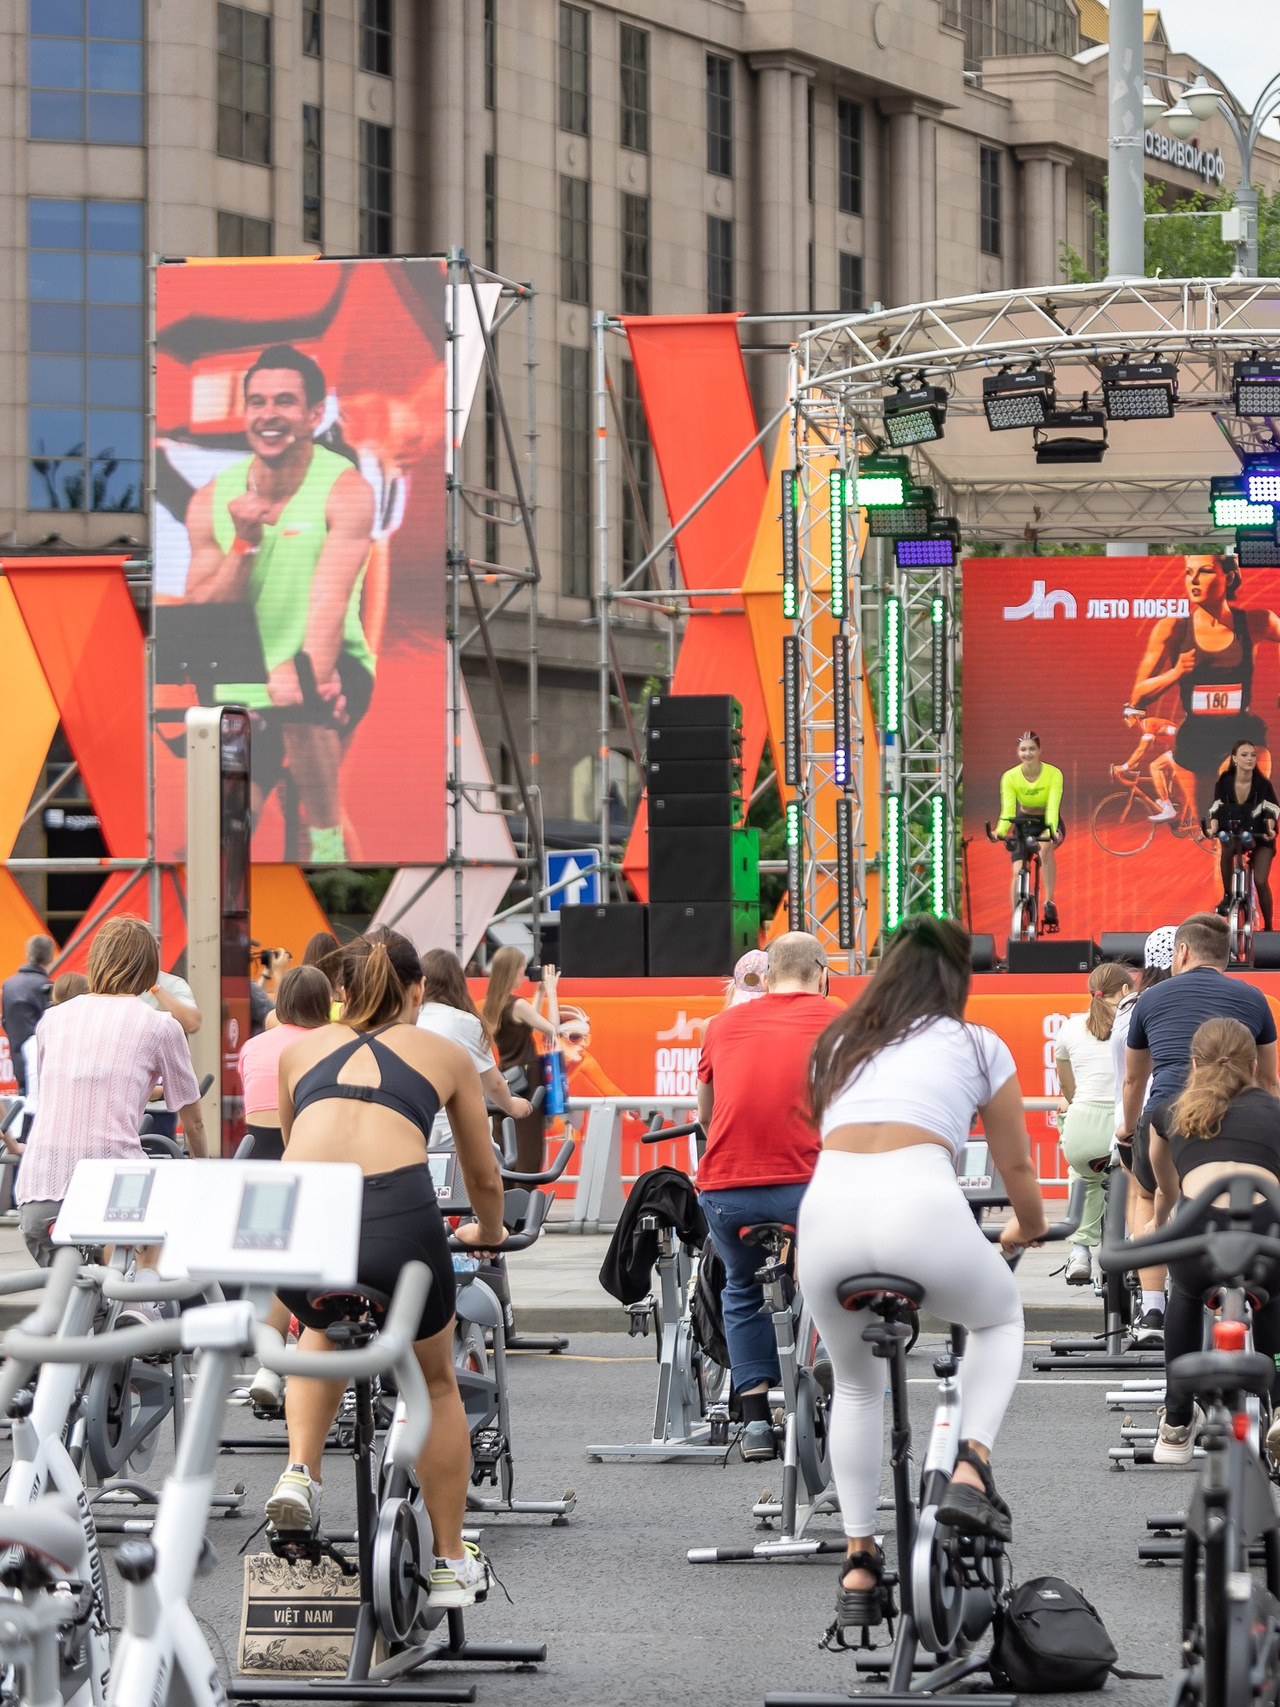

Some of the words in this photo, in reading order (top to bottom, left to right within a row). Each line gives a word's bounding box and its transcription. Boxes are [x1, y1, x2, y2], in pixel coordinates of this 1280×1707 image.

[1086, 599, 1129, 619] ЛЕТО
[1133, 598, 1190, 619] ПОБЕД
[274, 1606, 300, 1626] VIỆT
[304, 1609, 334, 1624] NAM
